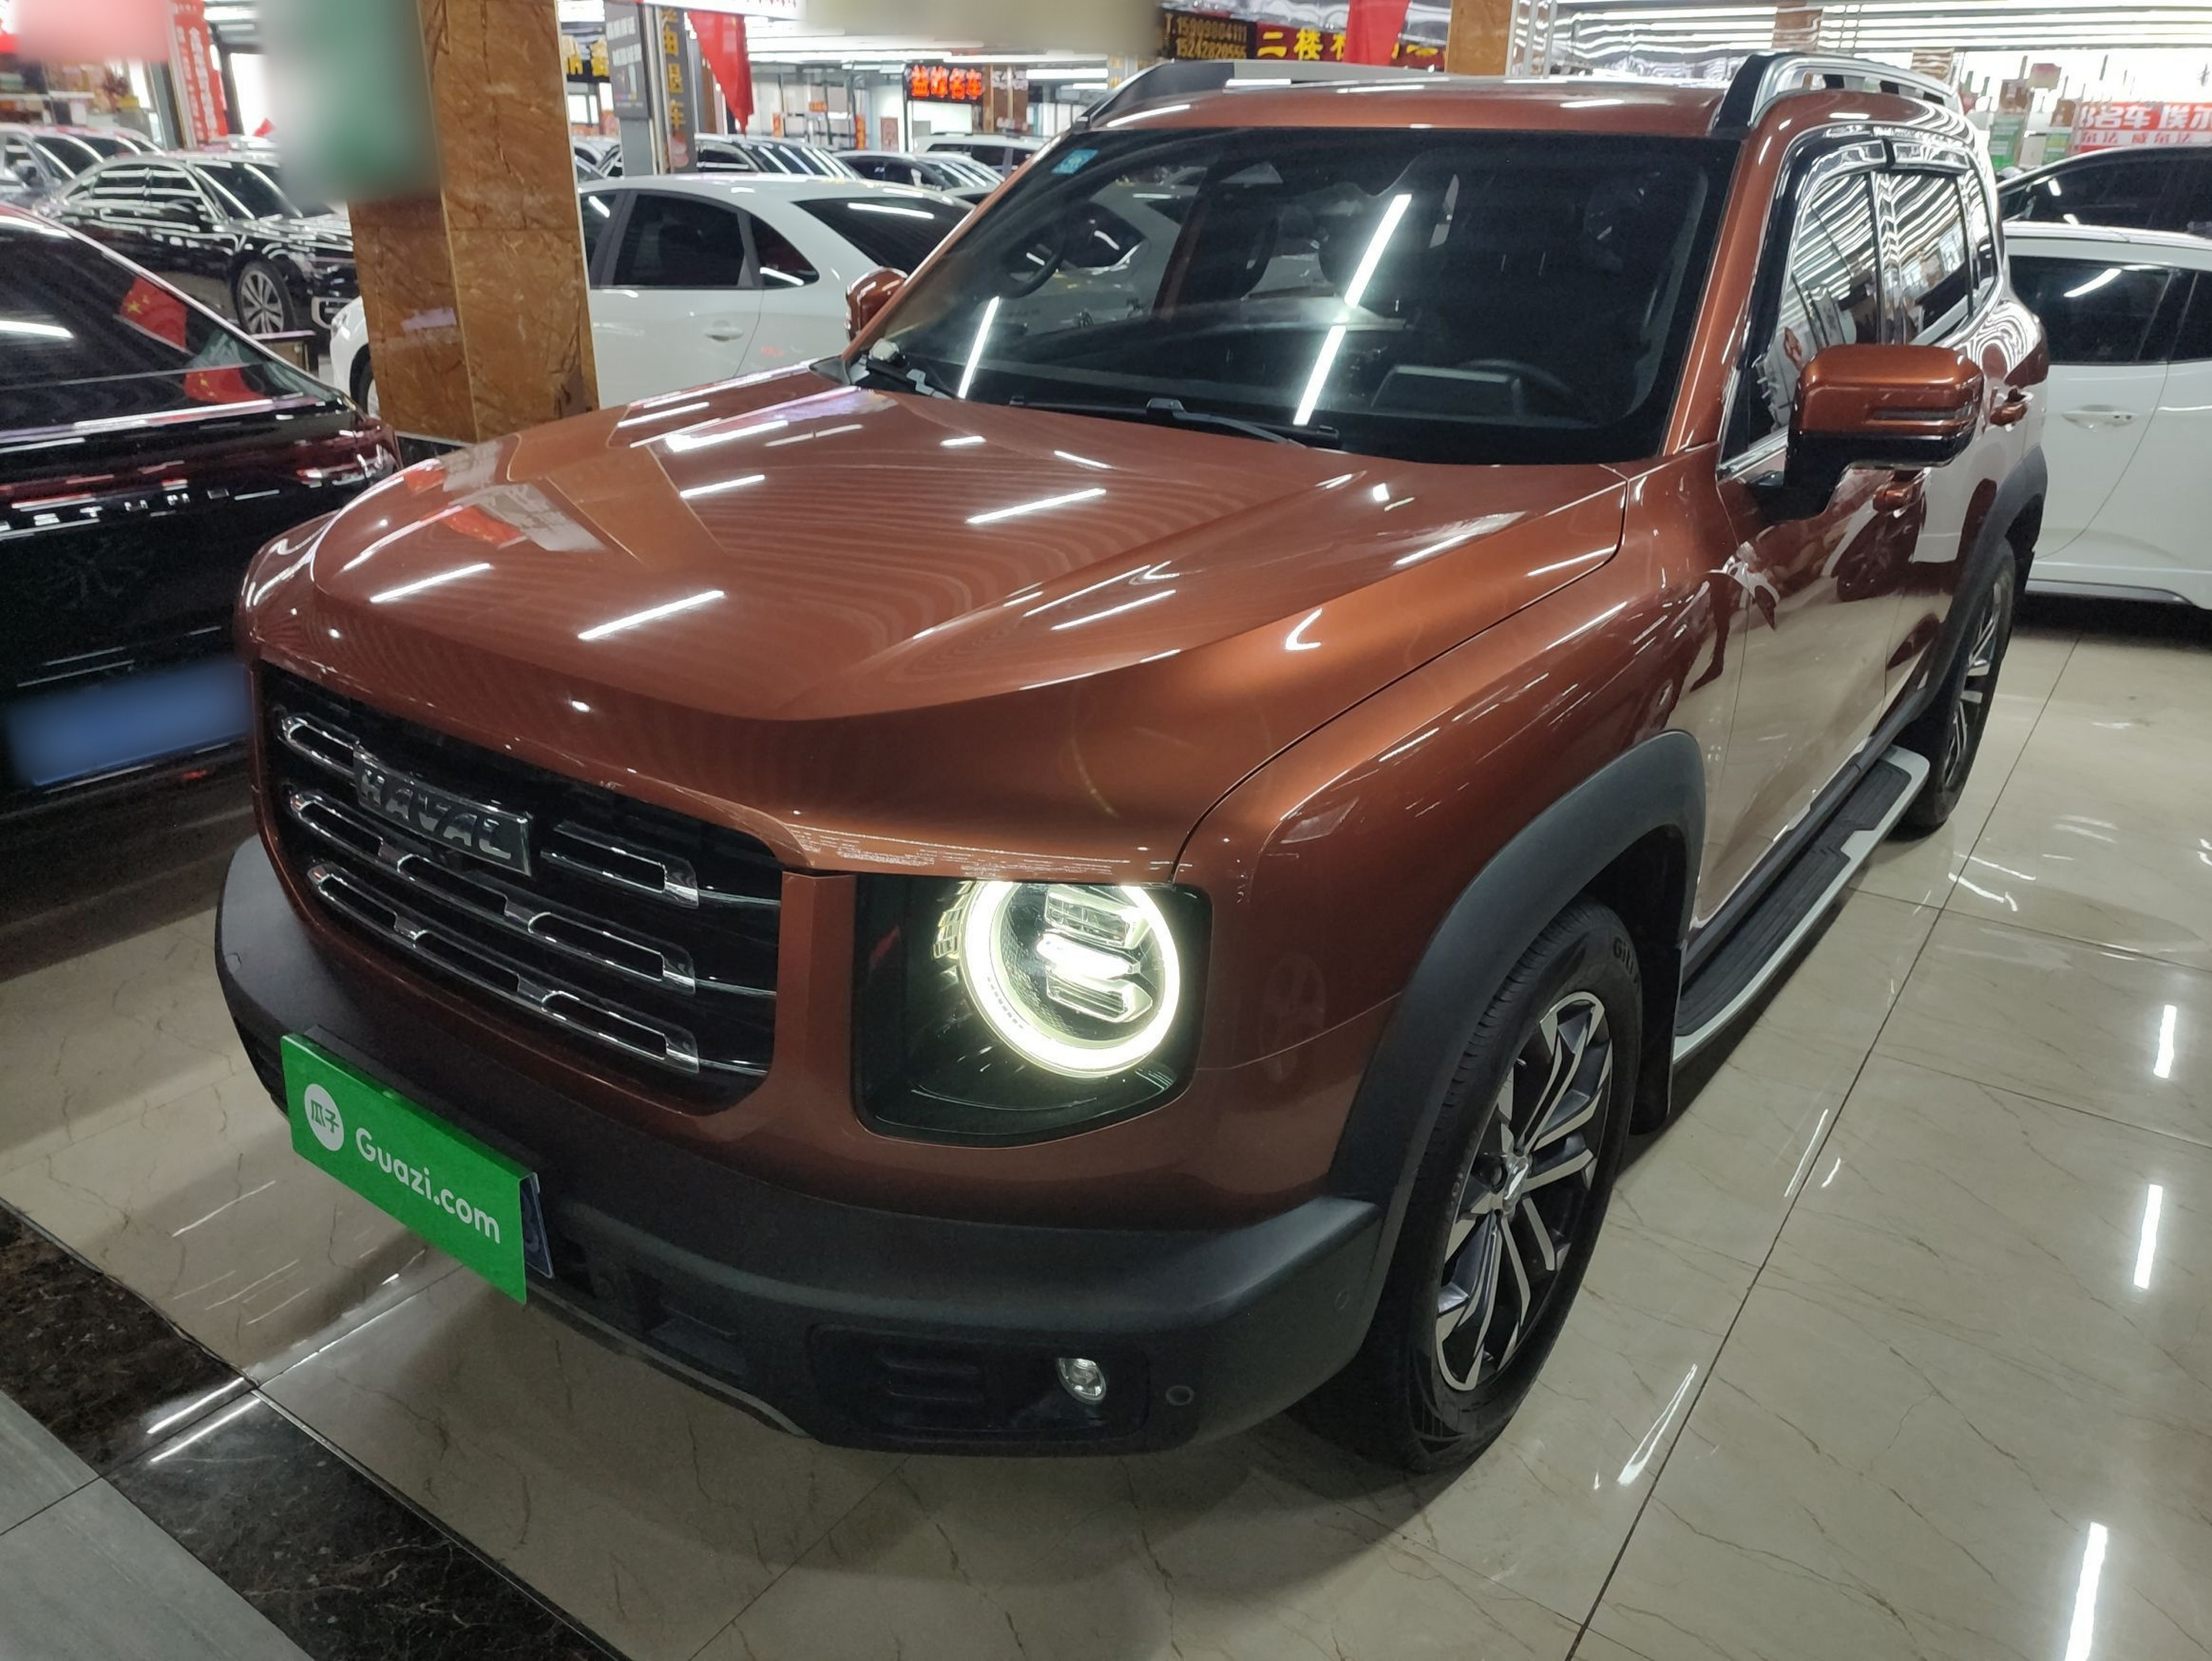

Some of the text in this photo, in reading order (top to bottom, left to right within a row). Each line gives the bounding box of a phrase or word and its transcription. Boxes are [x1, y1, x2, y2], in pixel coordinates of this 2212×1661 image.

[360, 768, 512, 861] HAVAL
[310, 1099, 340, 1134] 瓜子
[355, 1127, 501, 1244] Guazi.com
